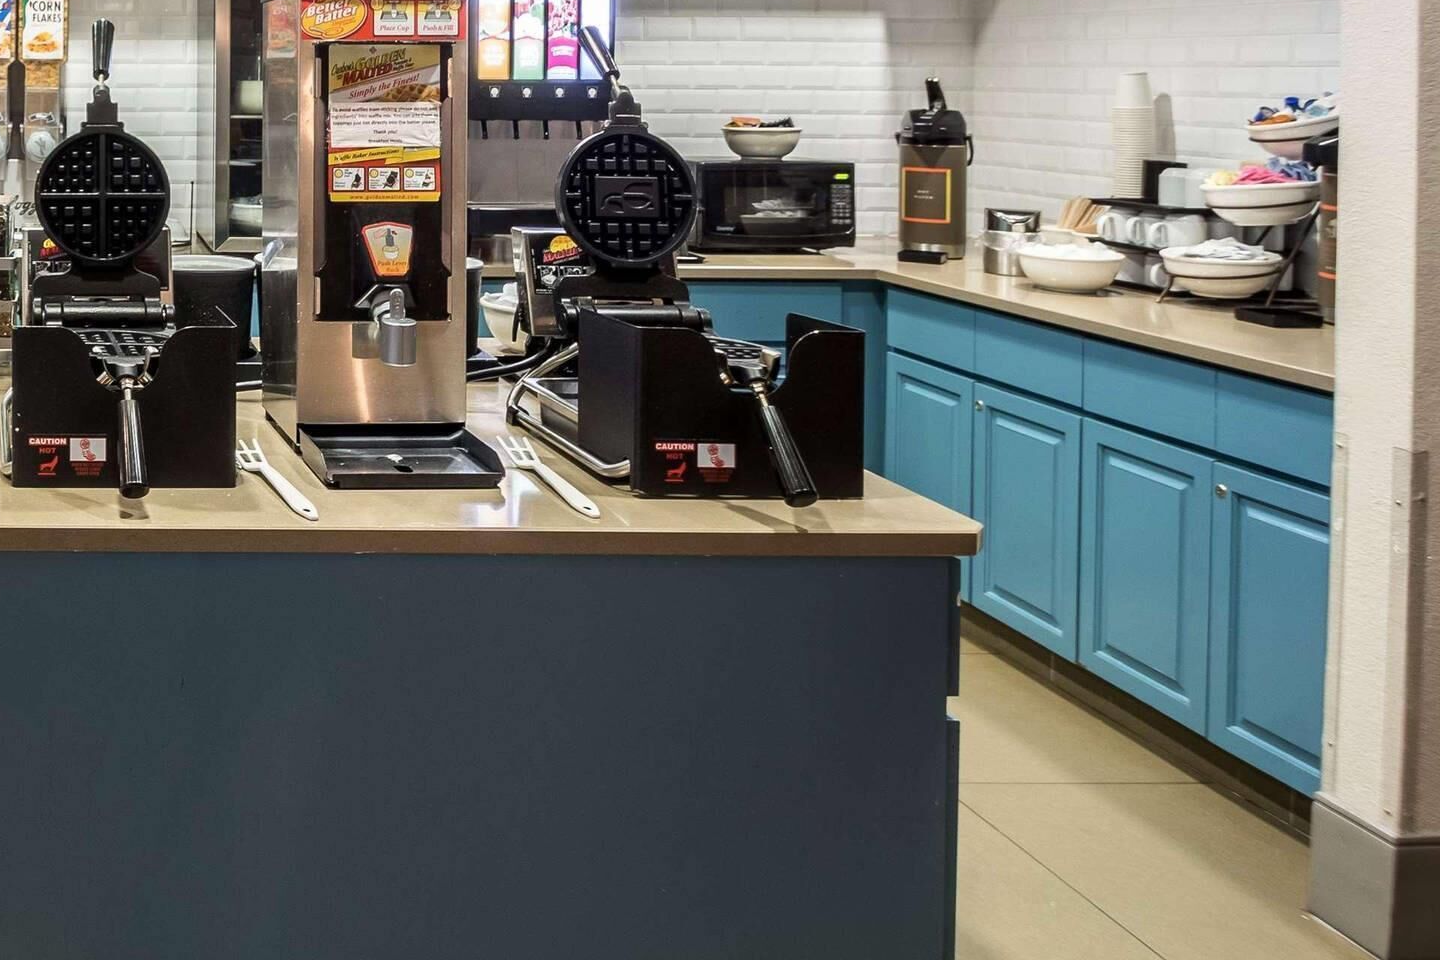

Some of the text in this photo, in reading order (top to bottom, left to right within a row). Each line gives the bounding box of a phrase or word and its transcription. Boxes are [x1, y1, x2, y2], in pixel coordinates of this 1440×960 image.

[32, 1, 61, 12] CORN
[32, 13, 61, 23] FLAKES
[315, 6, 357, 25] Batter
[380, 24, 410, 33] Place Cup
[342, 62, 393, 87] MALTED
[349, 73, 420, 99] Simply the Finest!
[28, 437, 67, 446] CAUTION
[655, 442, 695, 451] CAUTION
